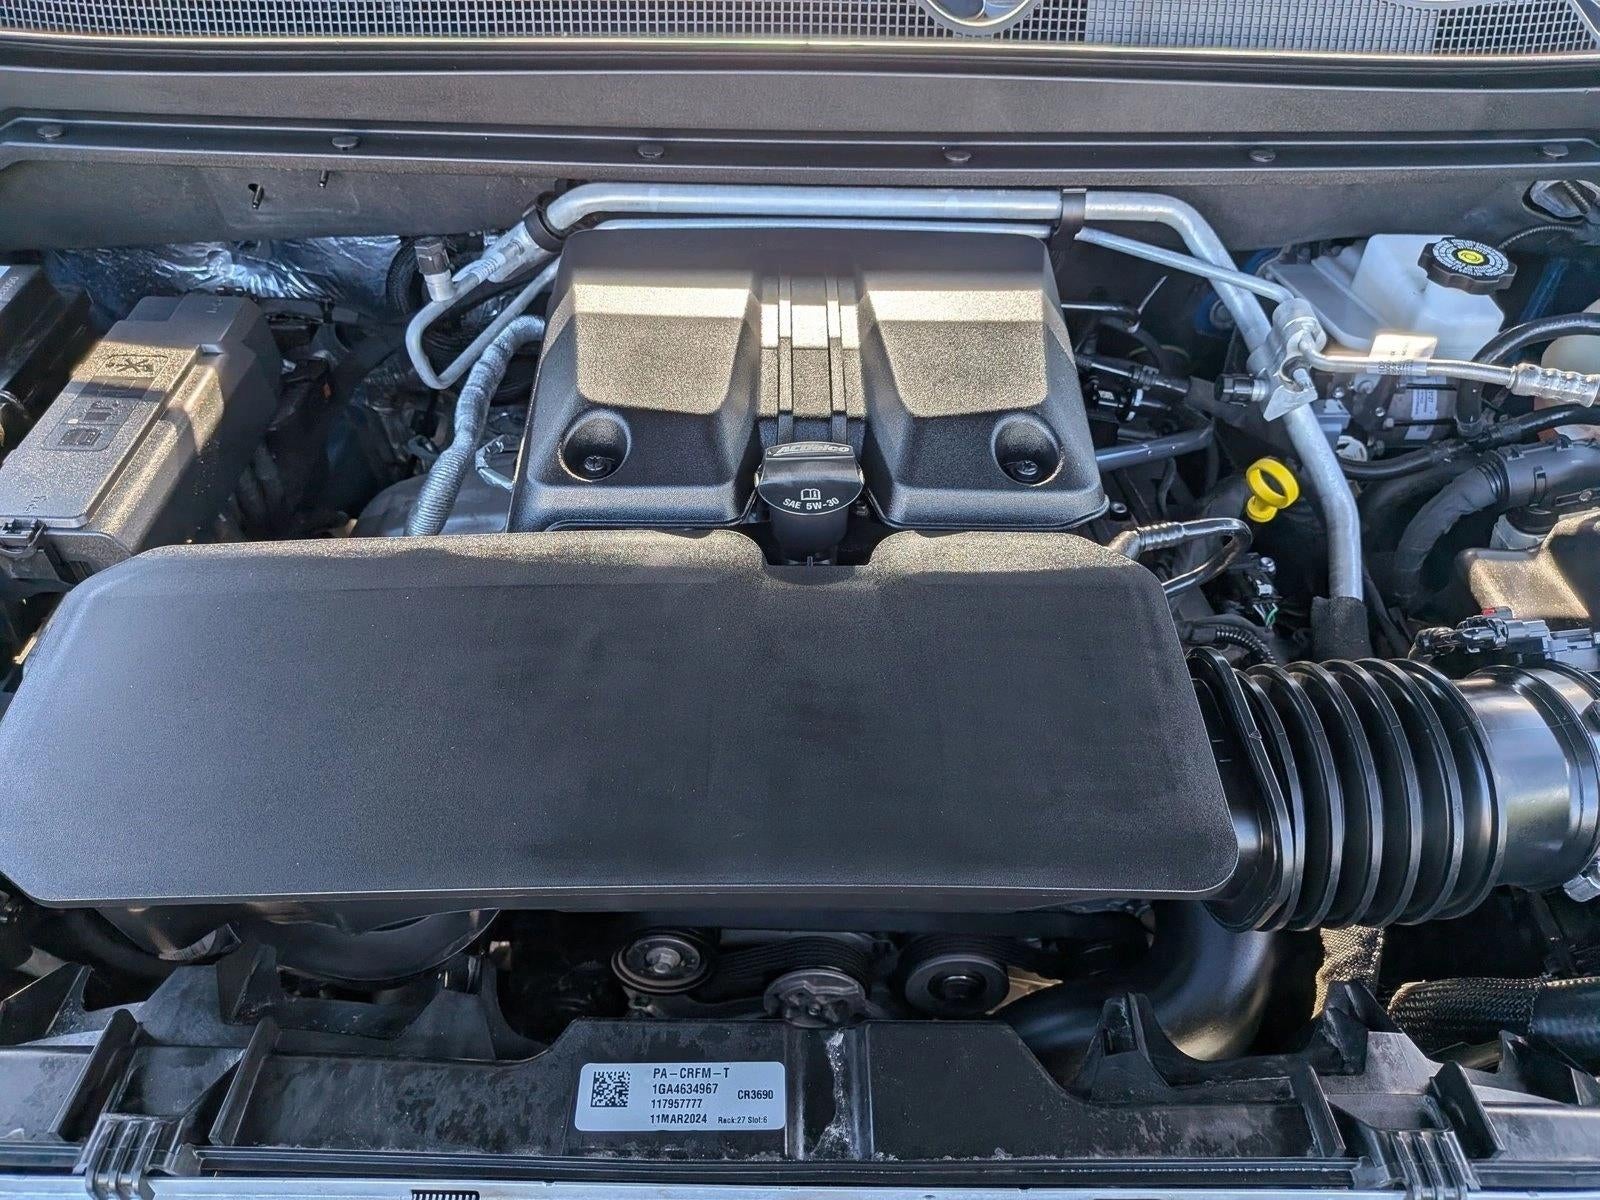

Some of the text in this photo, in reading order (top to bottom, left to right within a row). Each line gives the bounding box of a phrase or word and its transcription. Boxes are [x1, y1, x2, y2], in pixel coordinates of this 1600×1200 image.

[783, 497, 839, 510] SAE 5W-30
[652, 1083, 718, 1094] 1GA4634967
[737, 1090, 774, 1100] CR3690
[651, 1099, 703, 1109] 117957777
[650, 1114, 708, 1124] 11MAR2024
